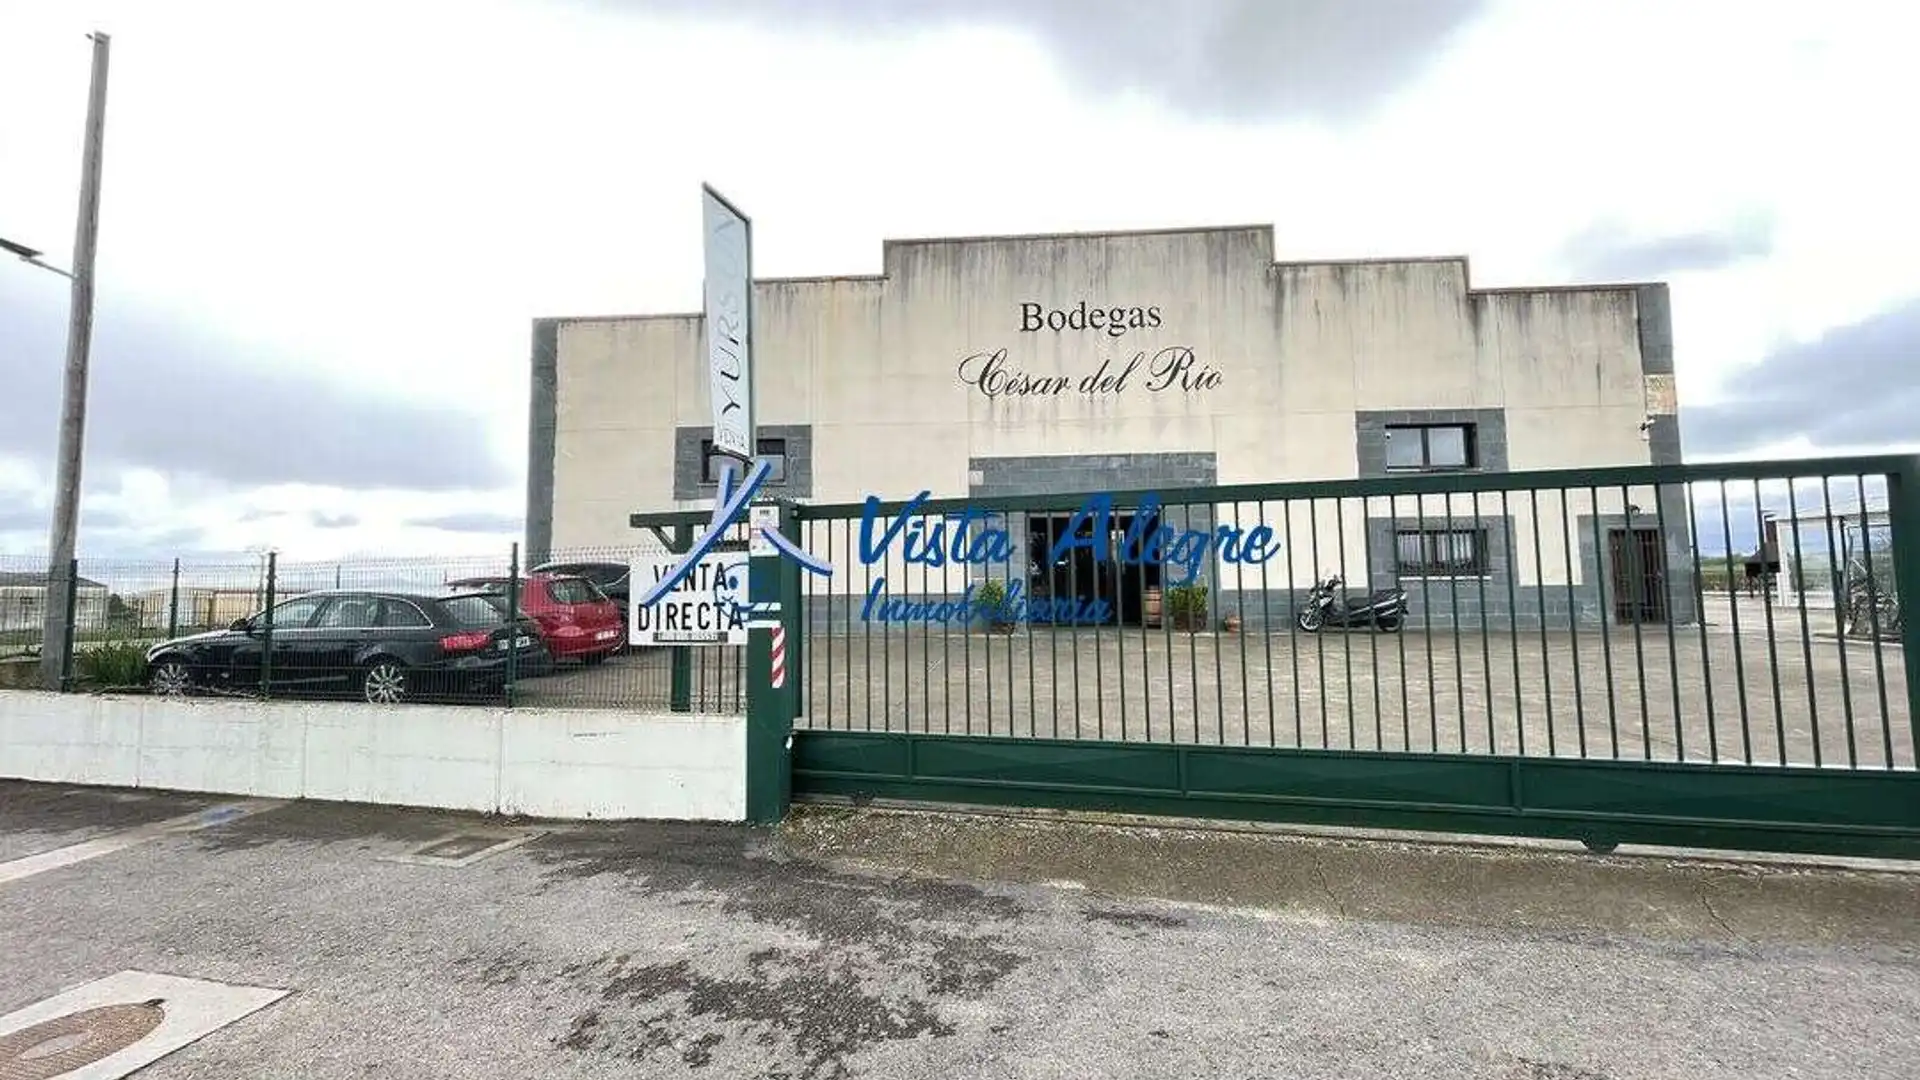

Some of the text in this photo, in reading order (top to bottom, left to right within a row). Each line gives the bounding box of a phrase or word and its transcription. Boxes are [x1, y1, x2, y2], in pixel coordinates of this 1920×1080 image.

[1020, 301, 1162, 338] Bodegas
[958, 346, 1224, 397] César del Río
[638, 602, 743, 631] DIRECTA
